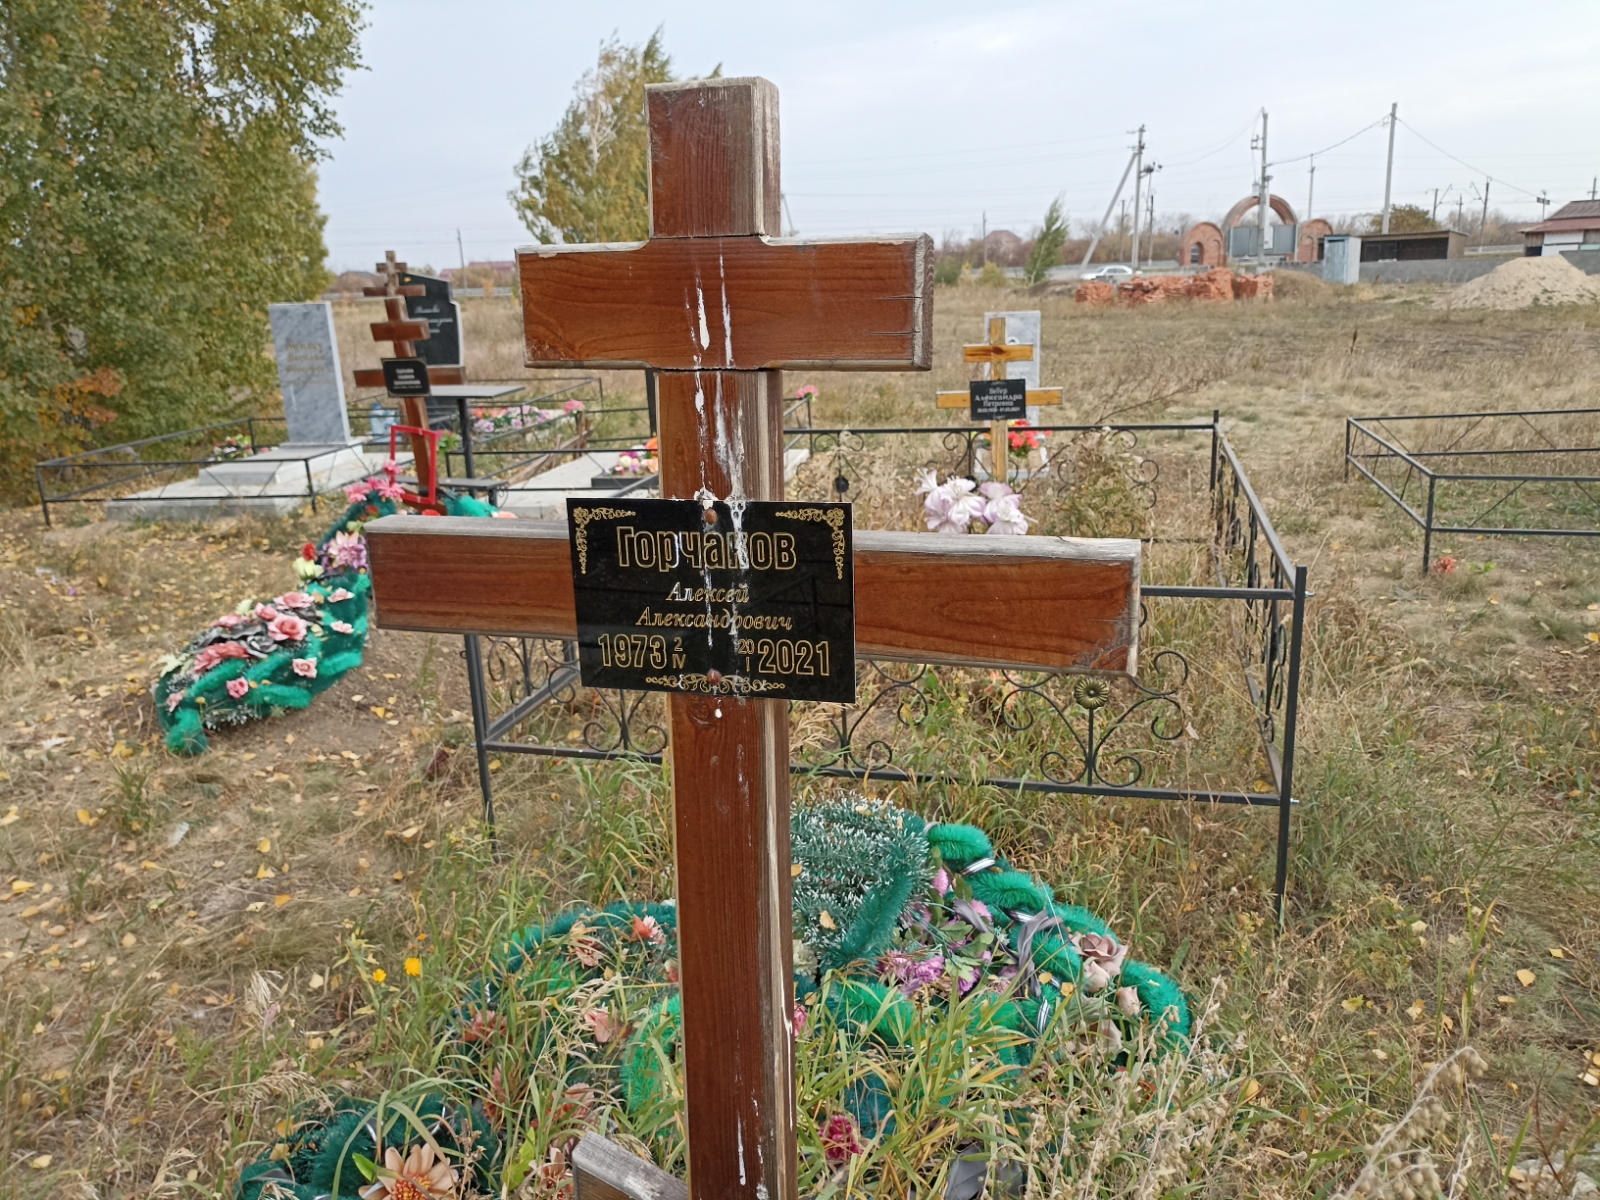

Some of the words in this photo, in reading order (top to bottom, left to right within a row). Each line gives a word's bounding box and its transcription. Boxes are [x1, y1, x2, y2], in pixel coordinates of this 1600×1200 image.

[616, 526, 797, 572] Горчаков
[666, 581, 749, 603] Алексей
[635, 606, 793, 635] Александрович
[598, 633, 667, 669] 1973
[673, 636, 683, 652] 2
[738, 638, 755, 655] 20
[757, 638, 830, 676] 2021
